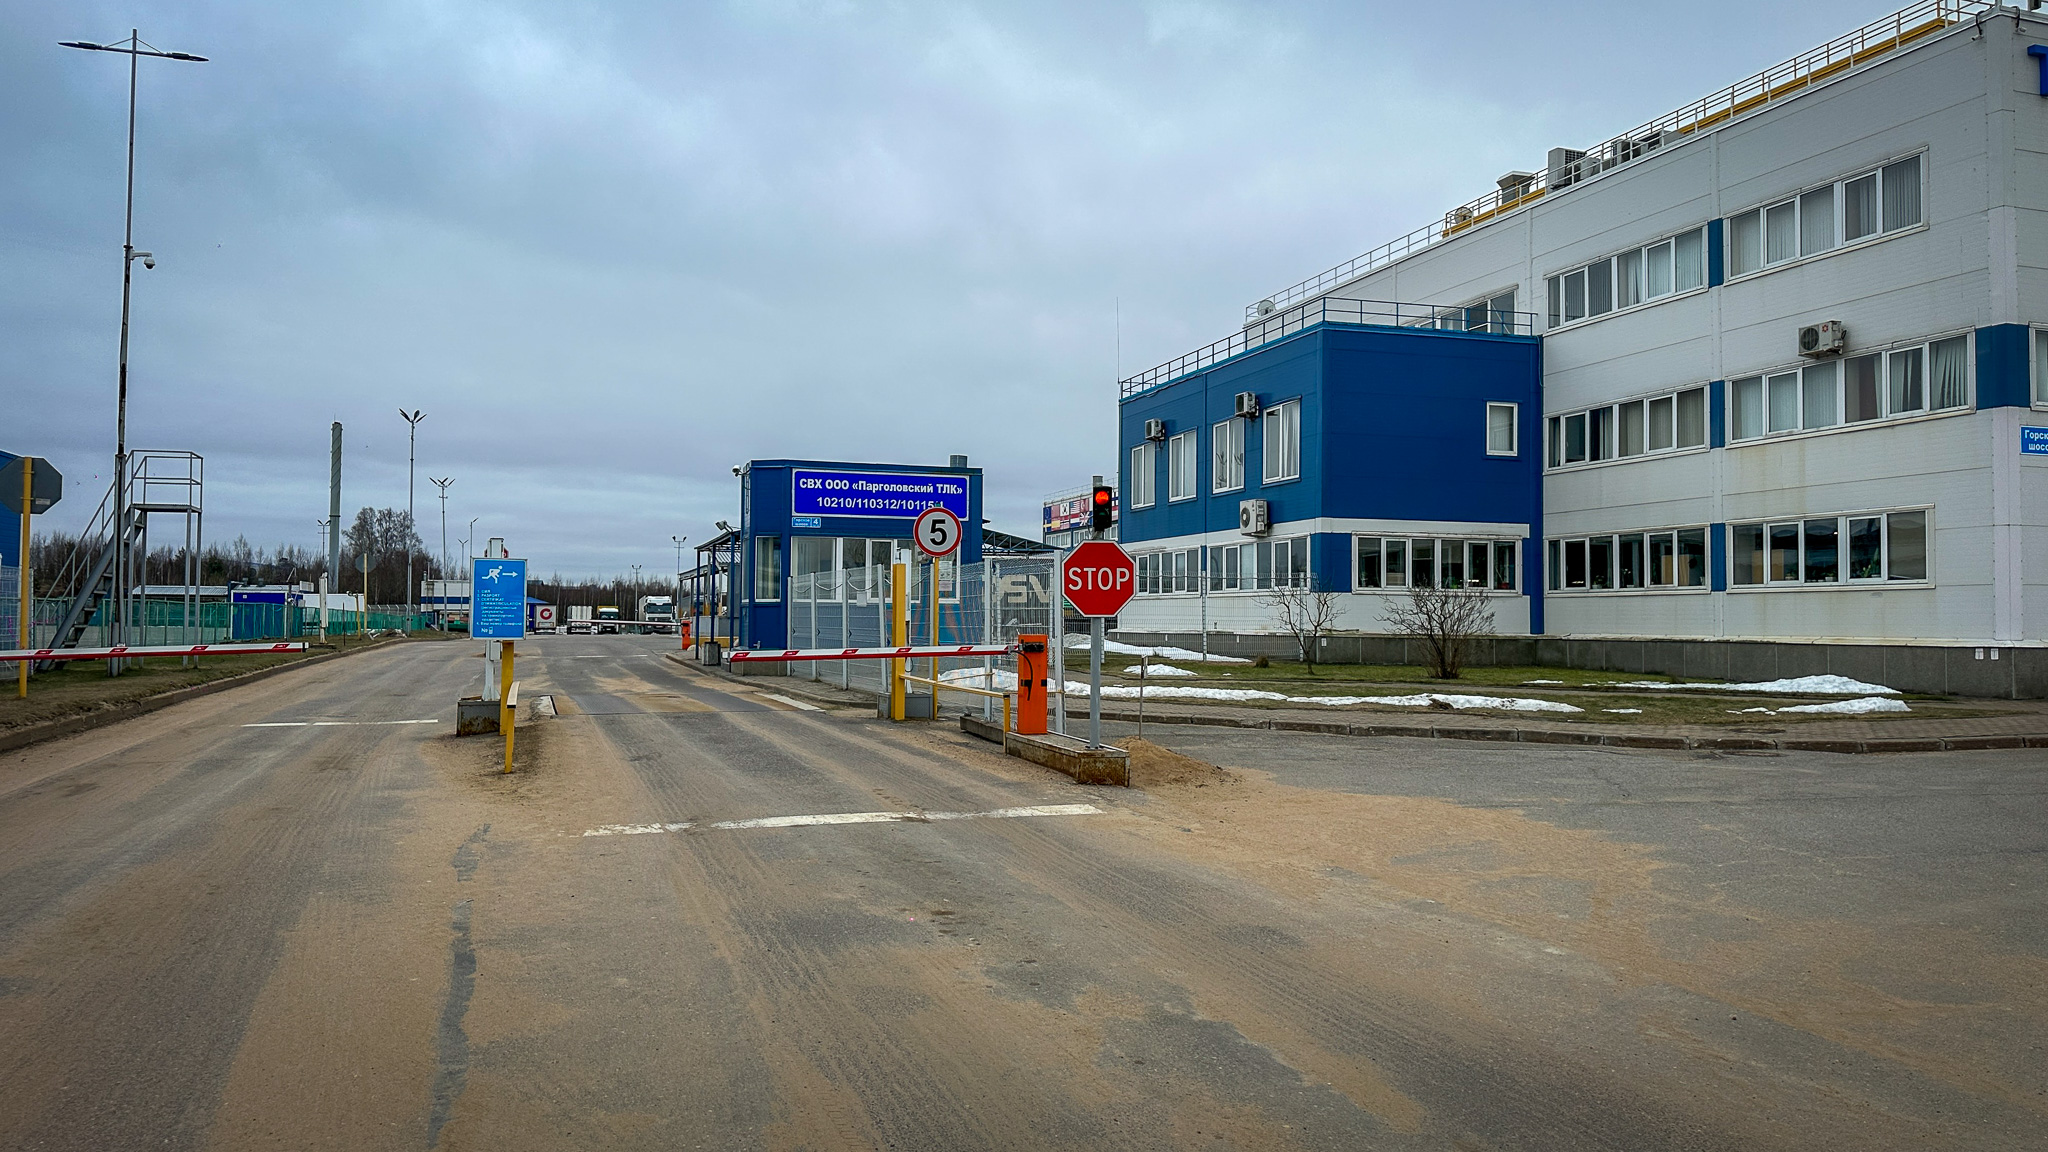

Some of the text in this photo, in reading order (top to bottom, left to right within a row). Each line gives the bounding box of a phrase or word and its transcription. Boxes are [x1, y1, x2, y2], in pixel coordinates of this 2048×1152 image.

[799, 478, 963, 494] СВХ ООО «Парголовский ТЛК»
[930, 519, 947, 546] 5
[1068, 567, 1130, 591] STOP
